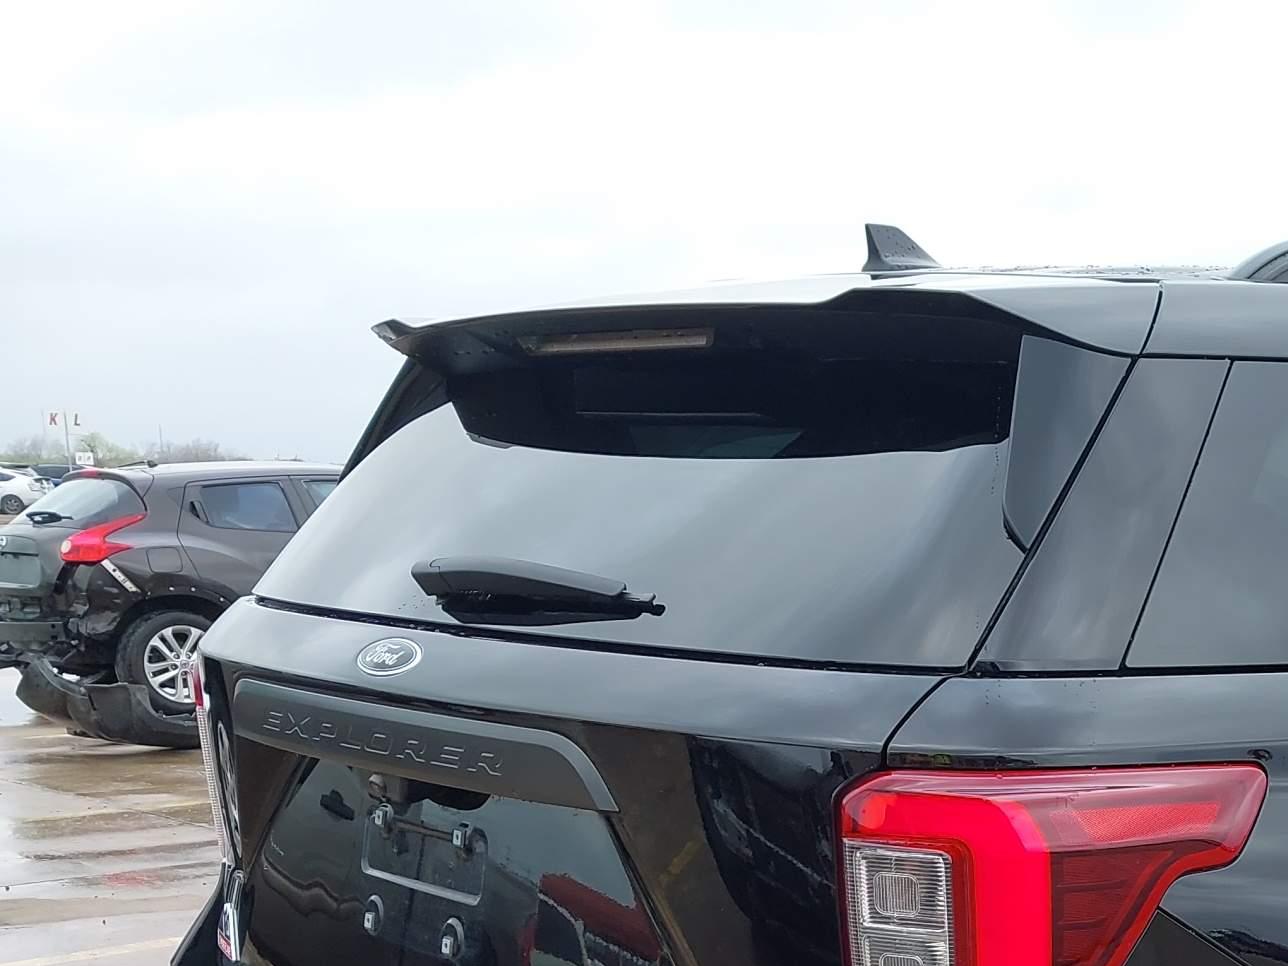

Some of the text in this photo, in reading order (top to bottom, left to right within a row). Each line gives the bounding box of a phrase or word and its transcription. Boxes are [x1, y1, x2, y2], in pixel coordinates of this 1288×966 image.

[49, 412, 58, 426] K
[74, 413, 81, 427] L
[365, 642, 405, 665] Ford
[262, 709, 504, 777] EXPLORER
